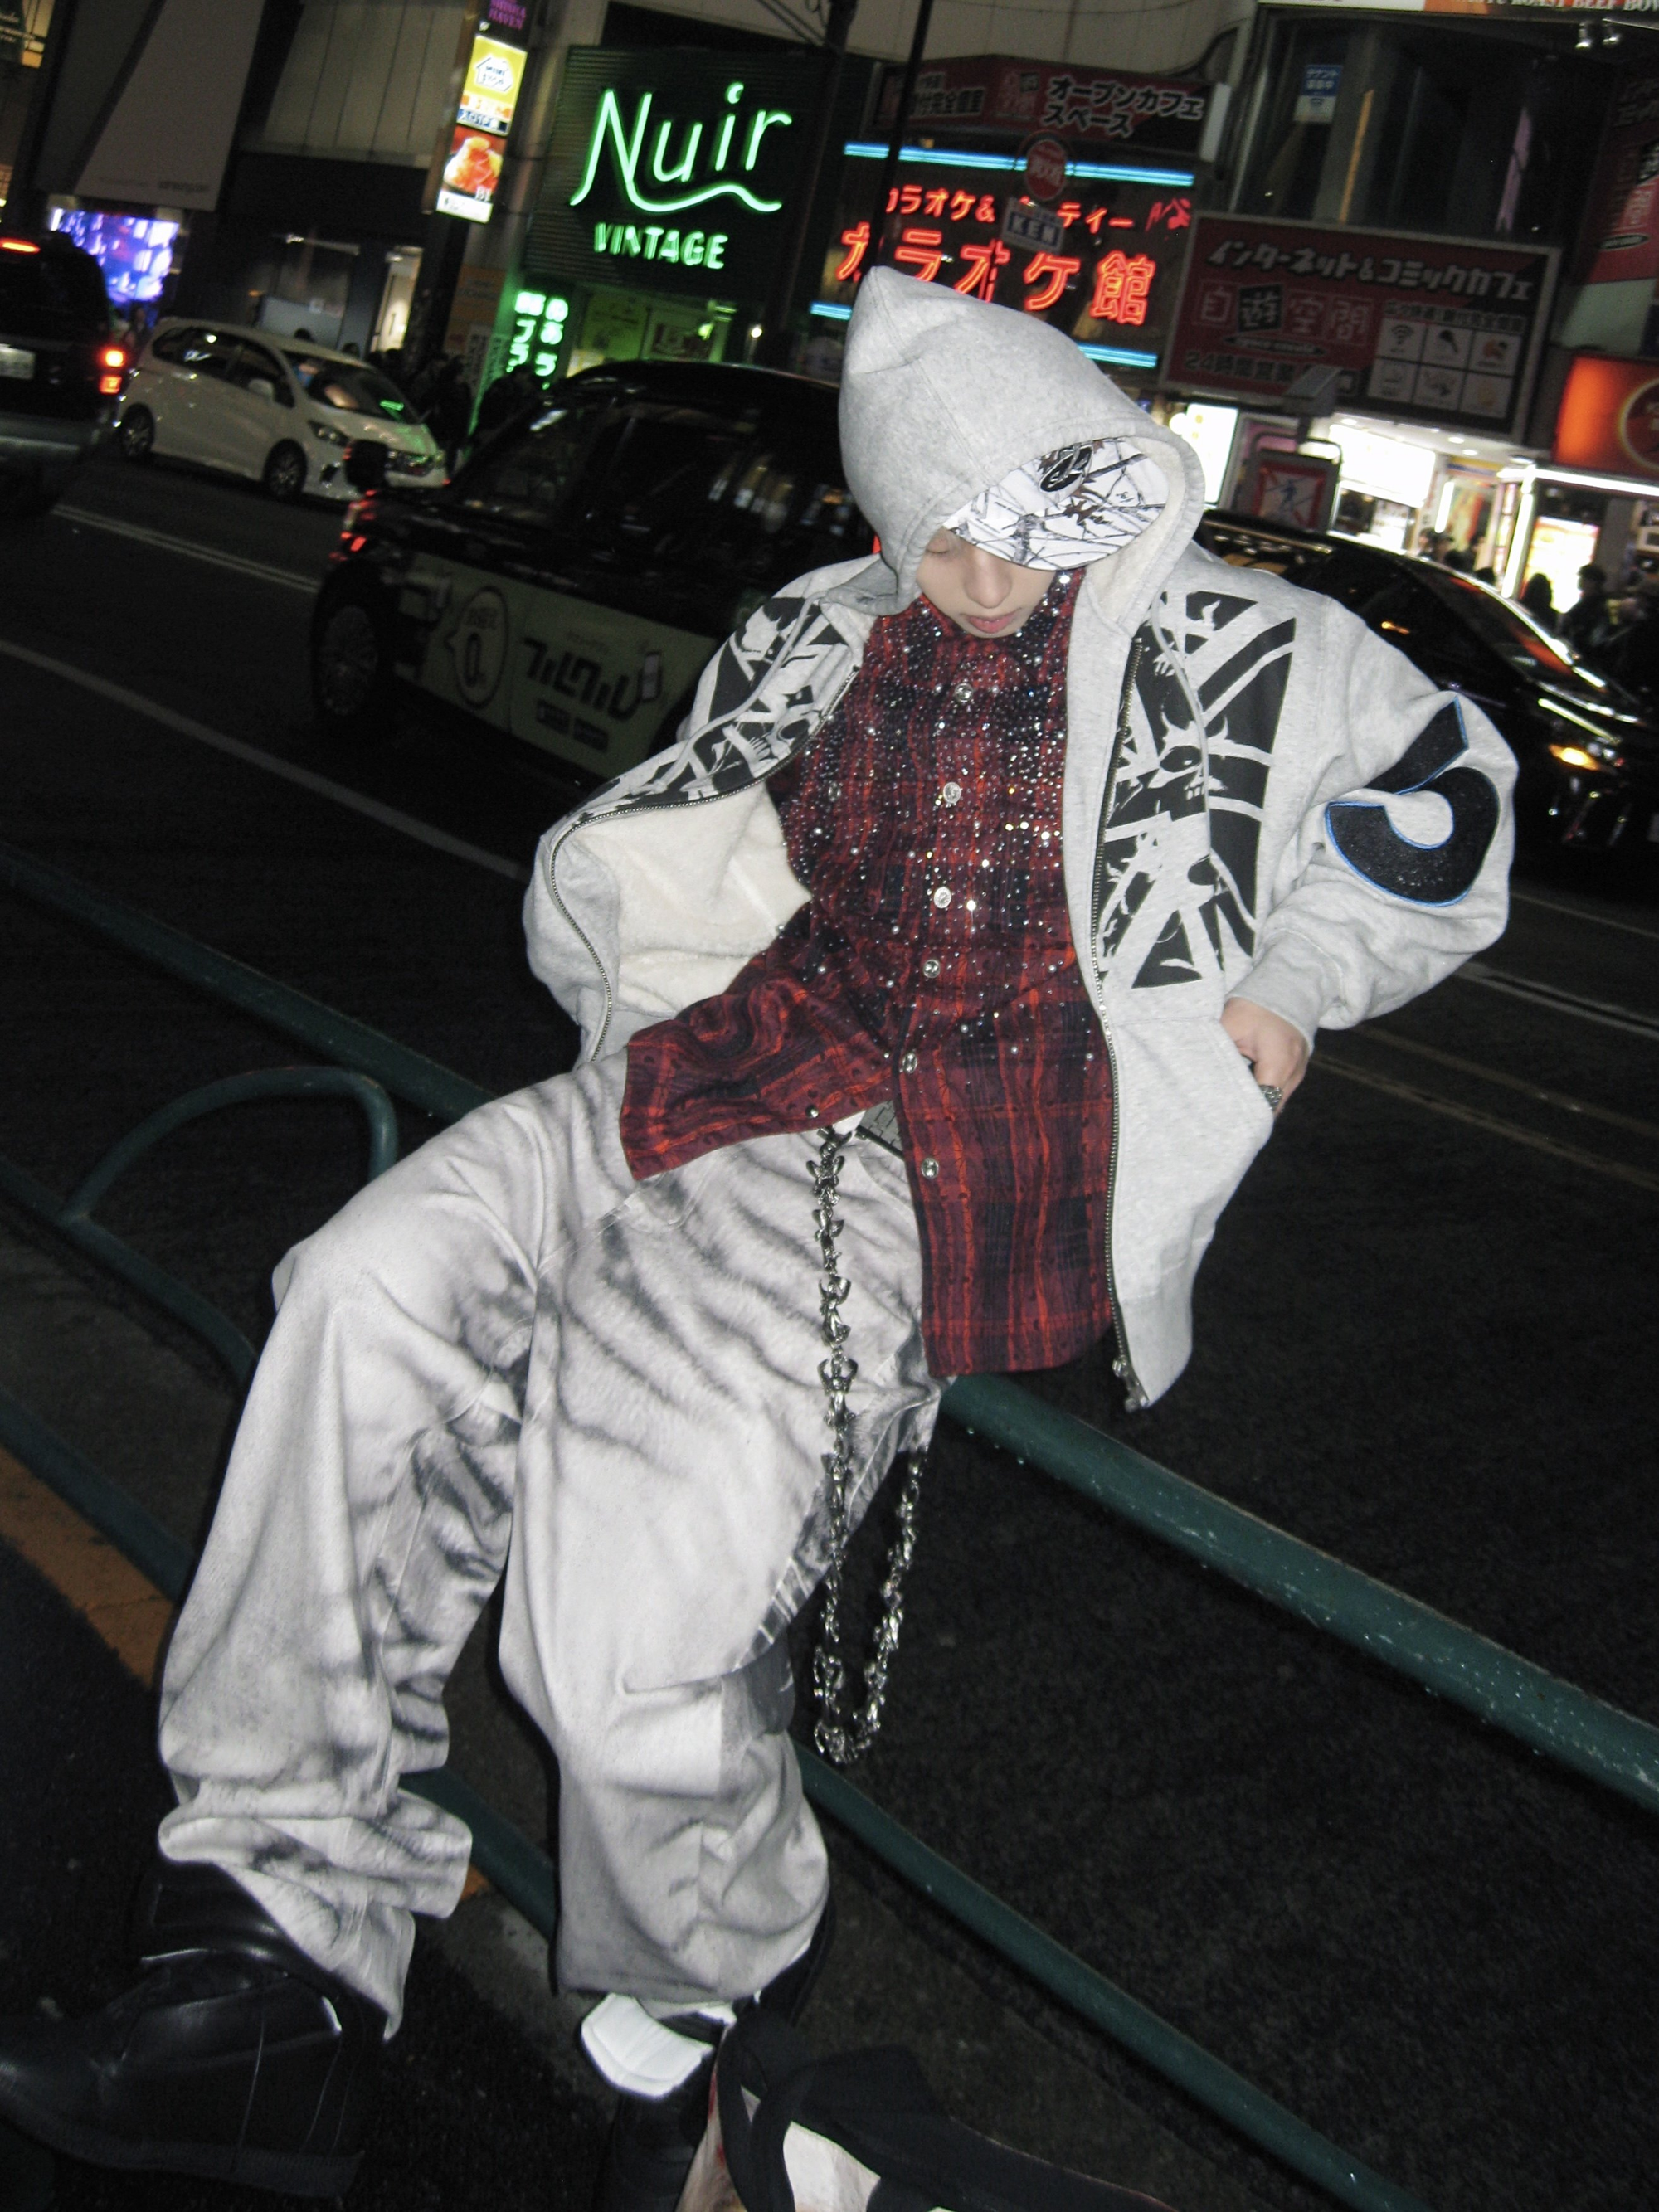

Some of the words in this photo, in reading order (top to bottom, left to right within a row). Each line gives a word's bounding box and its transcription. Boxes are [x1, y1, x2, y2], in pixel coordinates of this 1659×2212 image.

[1043, 103, 1134, 137] スペース
[1047, 75, 1204, 122] オープンカフェ
[570, 83, 792, 212] Nuir
[594, 221, 729, 270] VINTAGE
[1199, 283, 1368, 343] 自遊空間
